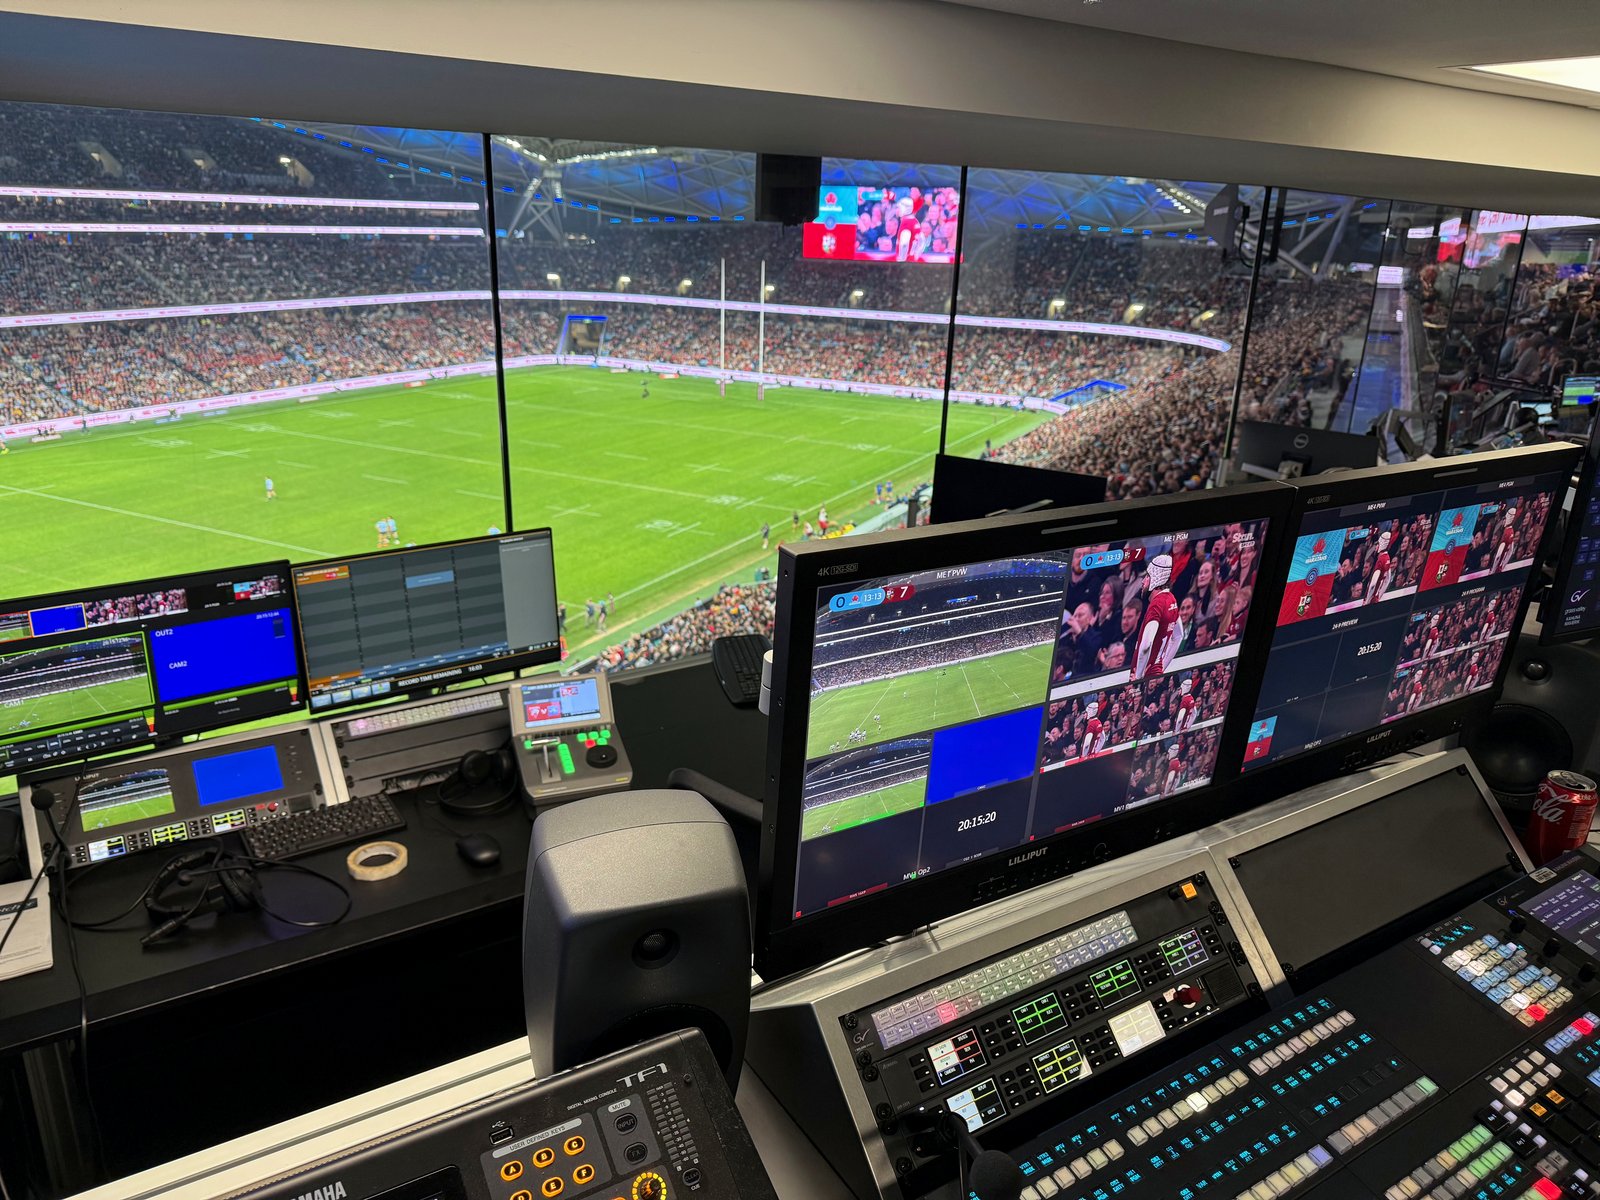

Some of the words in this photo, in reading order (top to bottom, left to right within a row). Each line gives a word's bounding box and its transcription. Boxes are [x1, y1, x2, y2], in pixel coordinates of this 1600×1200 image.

[1164, 535, 1175, 543] ME1
[1176, 532, 1189, 541] PGM
[1134, 548, 1142, 559] 7
[1084, 556, 1094, 566] 0
[818, 567, 830, 576] 4K
[952, 568, 968, 578] PVW
[864, 592, 882, 602] 13:13
[900, 586, 908, 598] 7
[836, 596, 846, 608] 0
[156, 628, 174, 638] OUT2
[1356, 641, 1383, 656] 20:15:20
[169, 660, 188, 670] CAM2
[398, 678, 420, 687] RECORD
[420, 674, 432, 682] TIME
[432, 668, 462, 680] REMAINING
[4, 700, 24, 708] CAM1
[1366, 730, 1392, 744] LILLIPUT
[958, 811, 997, 832] 20:15:20
[1008, 846, 1048, 867] LILLIPUT
[918, 866, 931, 878] Op2
[616, 1062, 668, 1088] TF1
[567, 1102, 582, 1111] DIGITAL
[584, 1095, 598, 1104] MIXING
[598, 1088, 617, 1099] CONSOLE
[612, 1101, 626, 1110] MUTE
[617, 1118, 634, 1128] INPUT
[510, 1142, 525, 1151] USER
[526, 1132, 549, 1144] DEFINED
[551, 1126, 566, 1135] KEYS
[632, 1149, 641, 1157] FX
[581, 1169, 587, 1177] F
[550, 1182, 556, 1190] E
